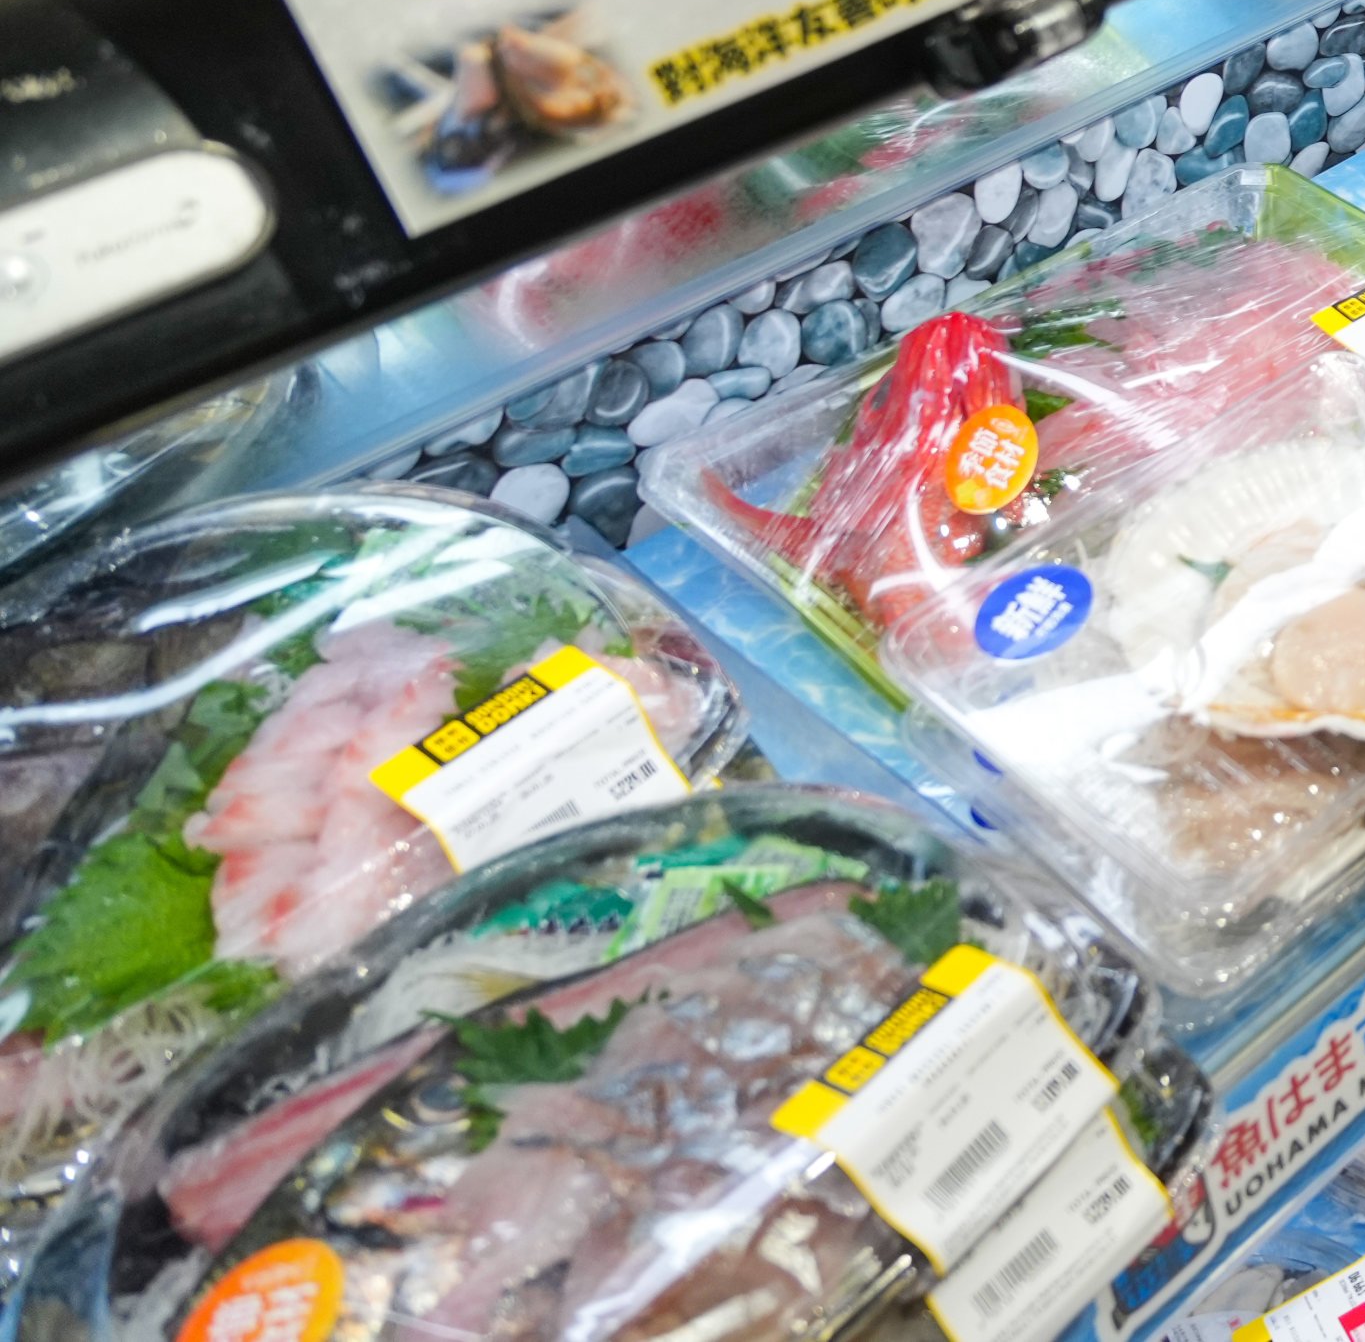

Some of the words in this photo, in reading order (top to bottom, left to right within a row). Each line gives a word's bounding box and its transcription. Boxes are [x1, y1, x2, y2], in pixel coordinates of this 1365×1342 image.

[984, 438, 1028, 491] 食材
[989, 572, 1067, 644] 新鮮
[1224, 1097, 1350, 1219] UOHAMA
